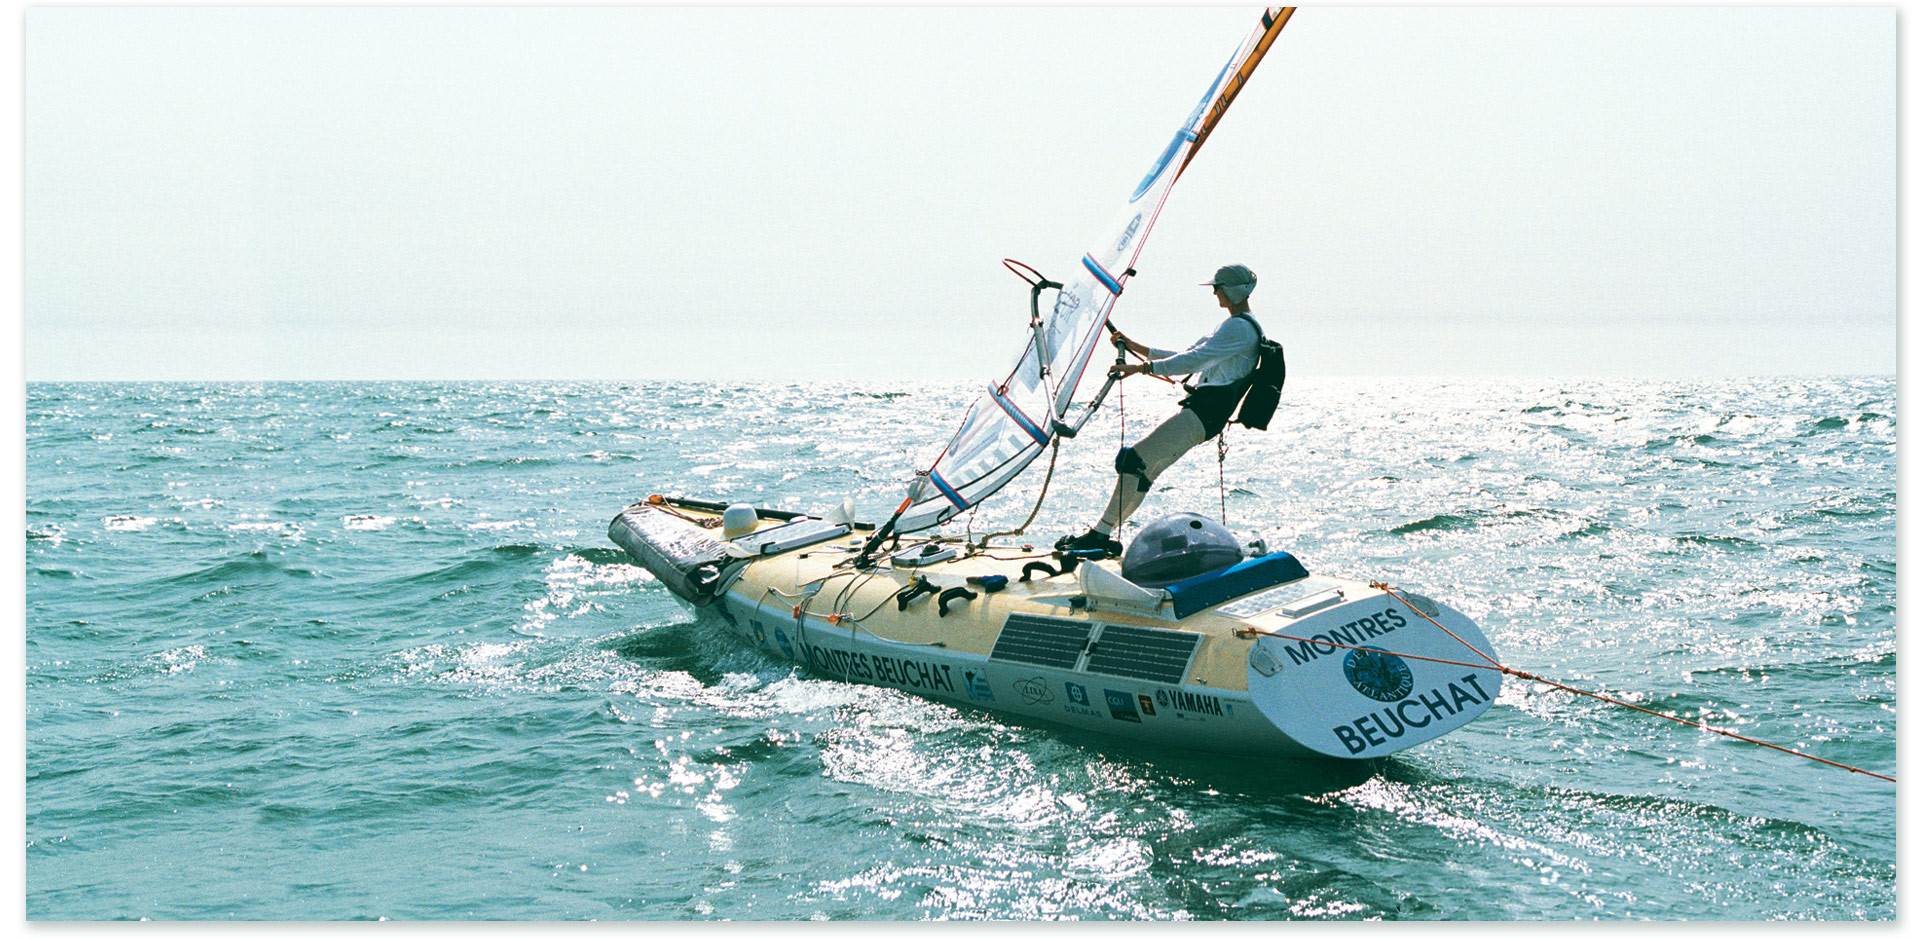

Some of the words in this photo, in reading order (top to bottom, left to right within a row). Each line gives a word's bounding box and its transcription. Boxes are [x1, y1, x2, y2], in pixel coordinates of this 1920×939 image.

[1284, 608, 1407, 666] MONTRES
[799, 642, 873, 679] MONTRES
[873, 655, 955, 692] BEUCHAT
[1064, 704, 1103, 718] DELMAS
[1168, 689, 1224, 717] YAMAHA
[1333, 673, 1490, 755] BEUCHAT
